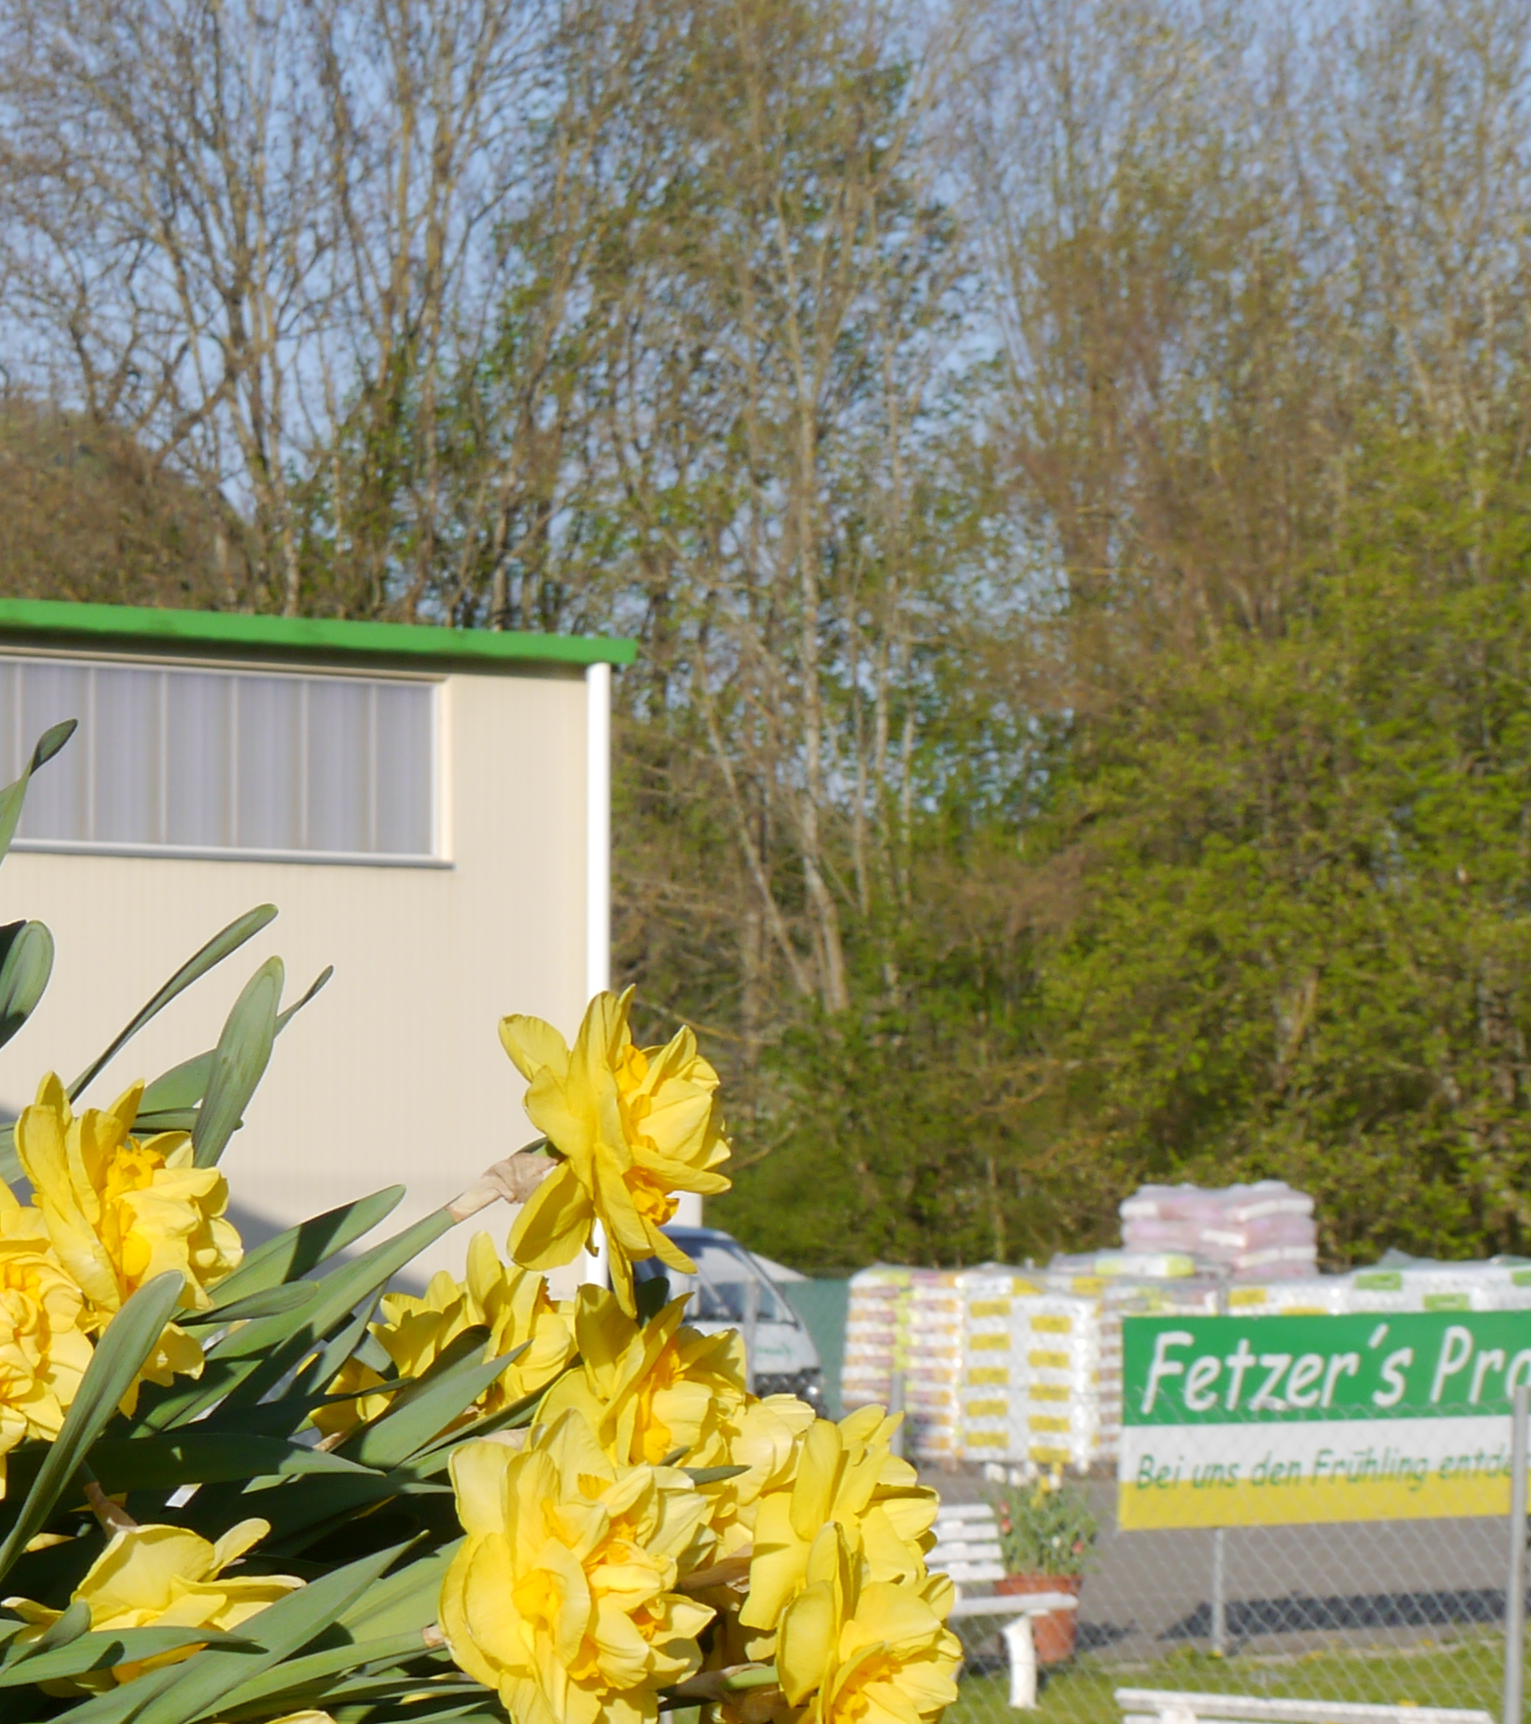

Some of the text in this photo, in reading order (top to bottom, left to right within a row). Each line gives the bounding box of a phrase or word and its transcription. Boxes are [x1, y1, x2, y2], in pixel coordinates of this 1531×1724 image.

[1136, 1454, 1184, 1489] Bei
[1192, 1462, 1239, 1489] uns
[1250, 1451, 1302, 1487] den
[1313, 1448, 1428, 1491] Frühling
